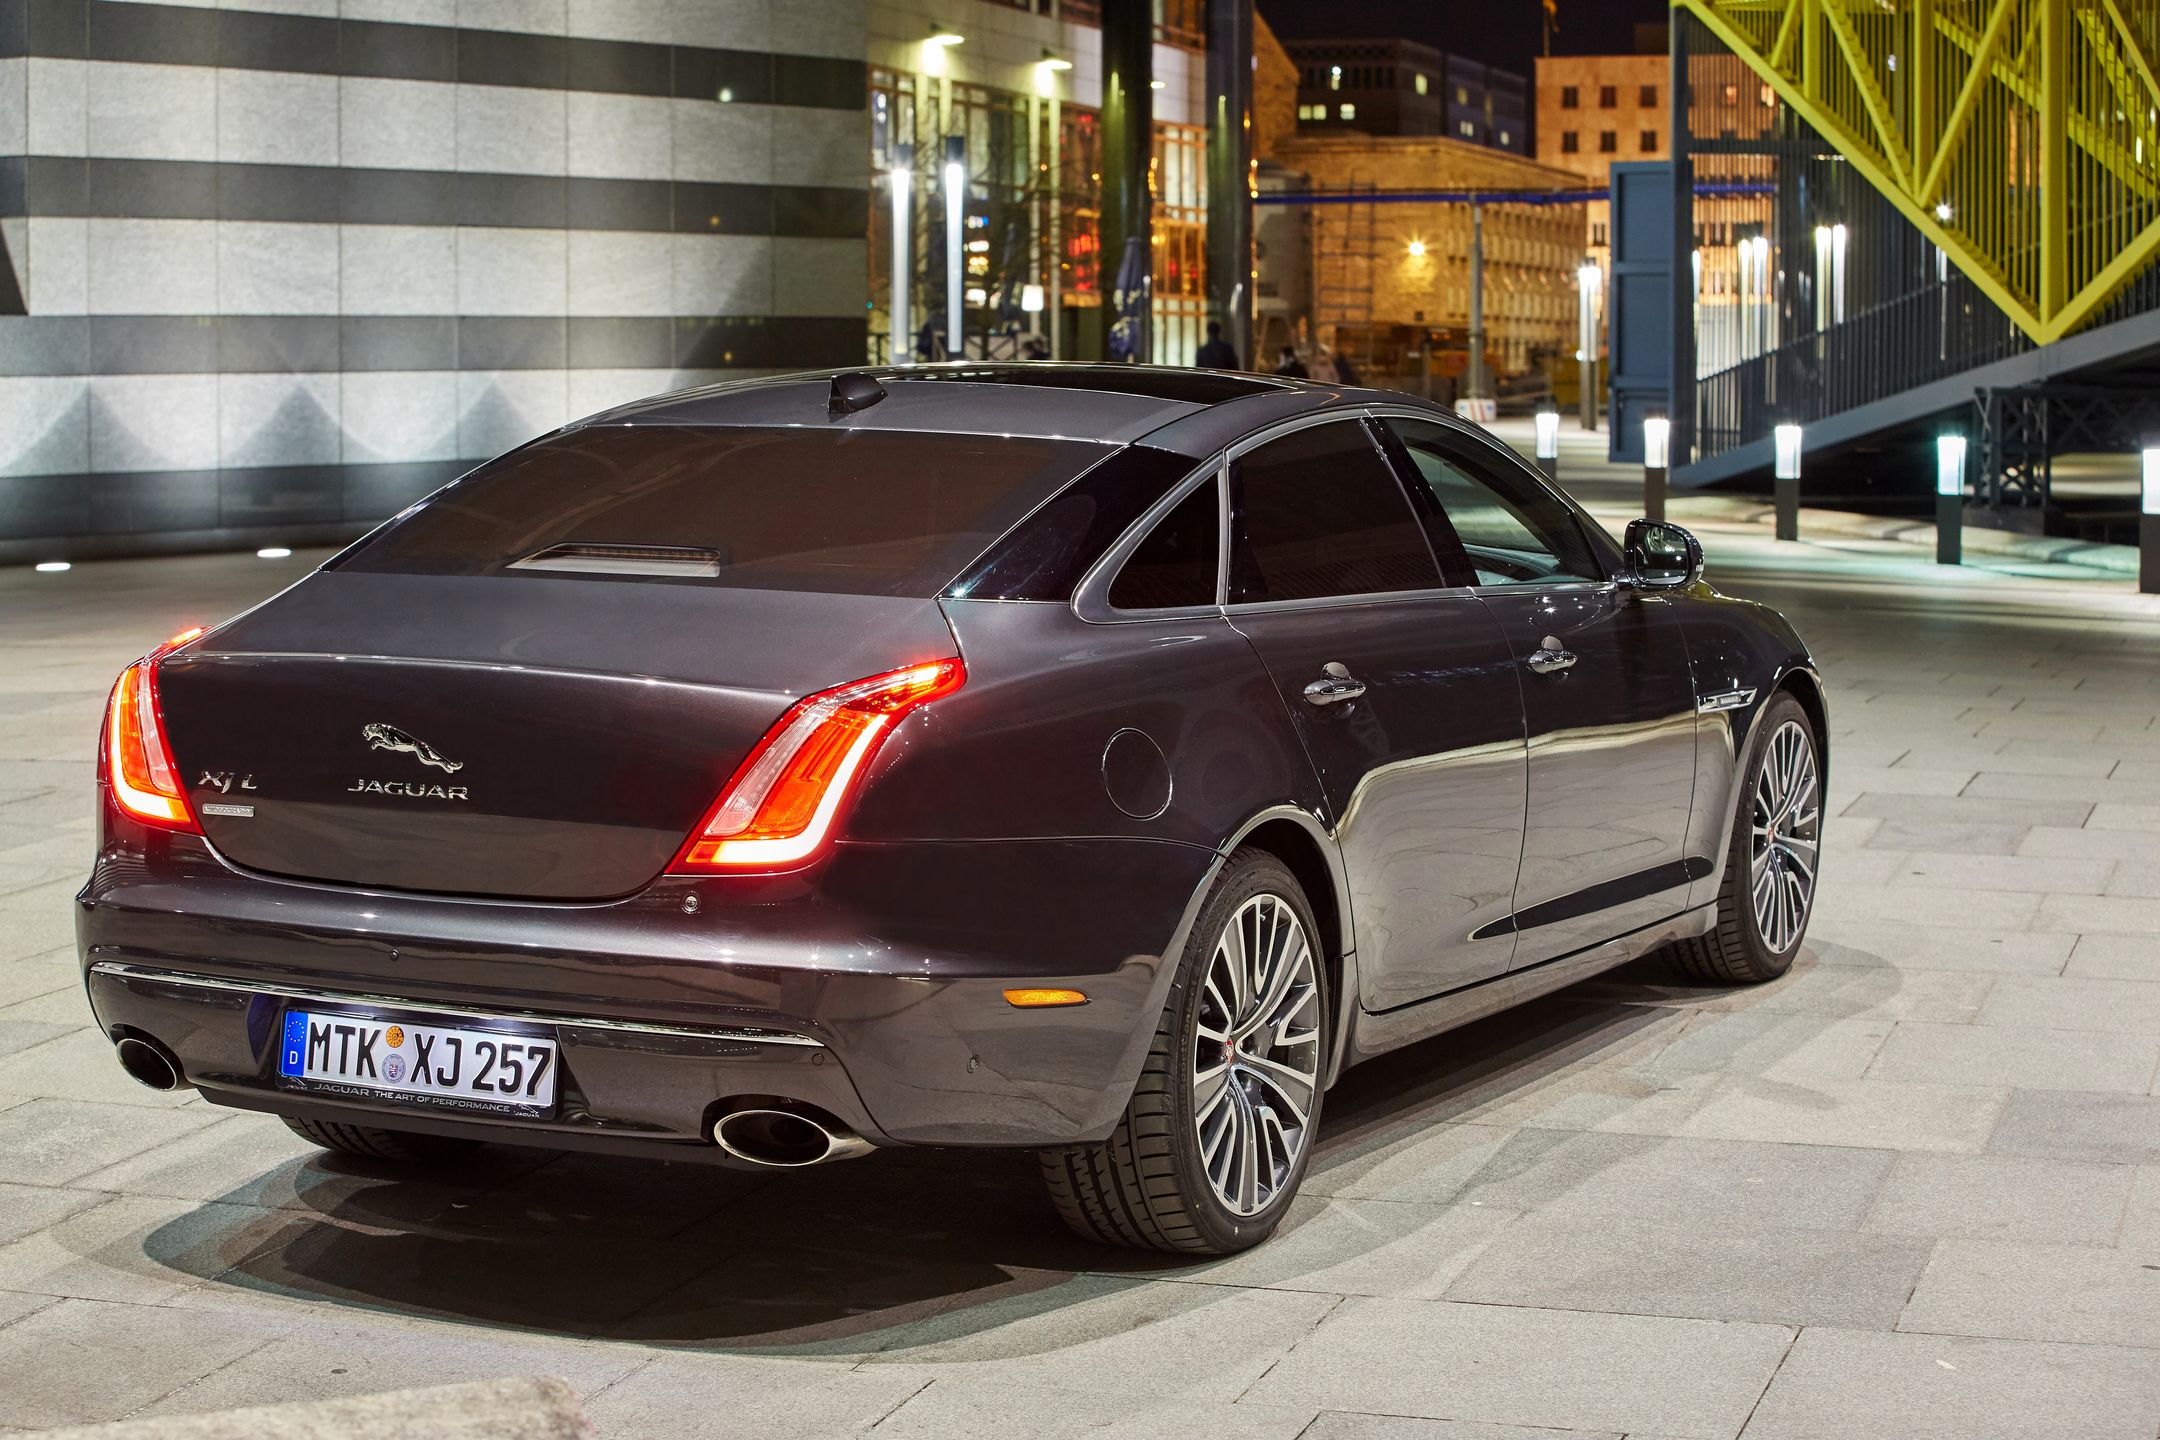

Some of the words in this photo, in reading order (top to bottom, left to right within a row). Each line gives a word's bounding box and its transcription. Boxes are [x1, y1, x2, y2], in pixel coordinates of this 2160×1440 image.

[198, 771, 236, 793] XJ
[348, 778, 469, 800] JAGUAR
[289, 1051, 298, 1065] D
[307, 1021, 381, 1078] MTK
[410, 1033, 462, 1087] XJ
[471, 1041, 552, 1097] 257
[314, 1083, 370, 1096] JAGUAR
[374, 1090, 394, 1099] THE
[395, 1093, 415, 1102] ART
[417, 1095, 430, 1103] OF
[432, 1097, 510, 1113] PERFORMANCE
